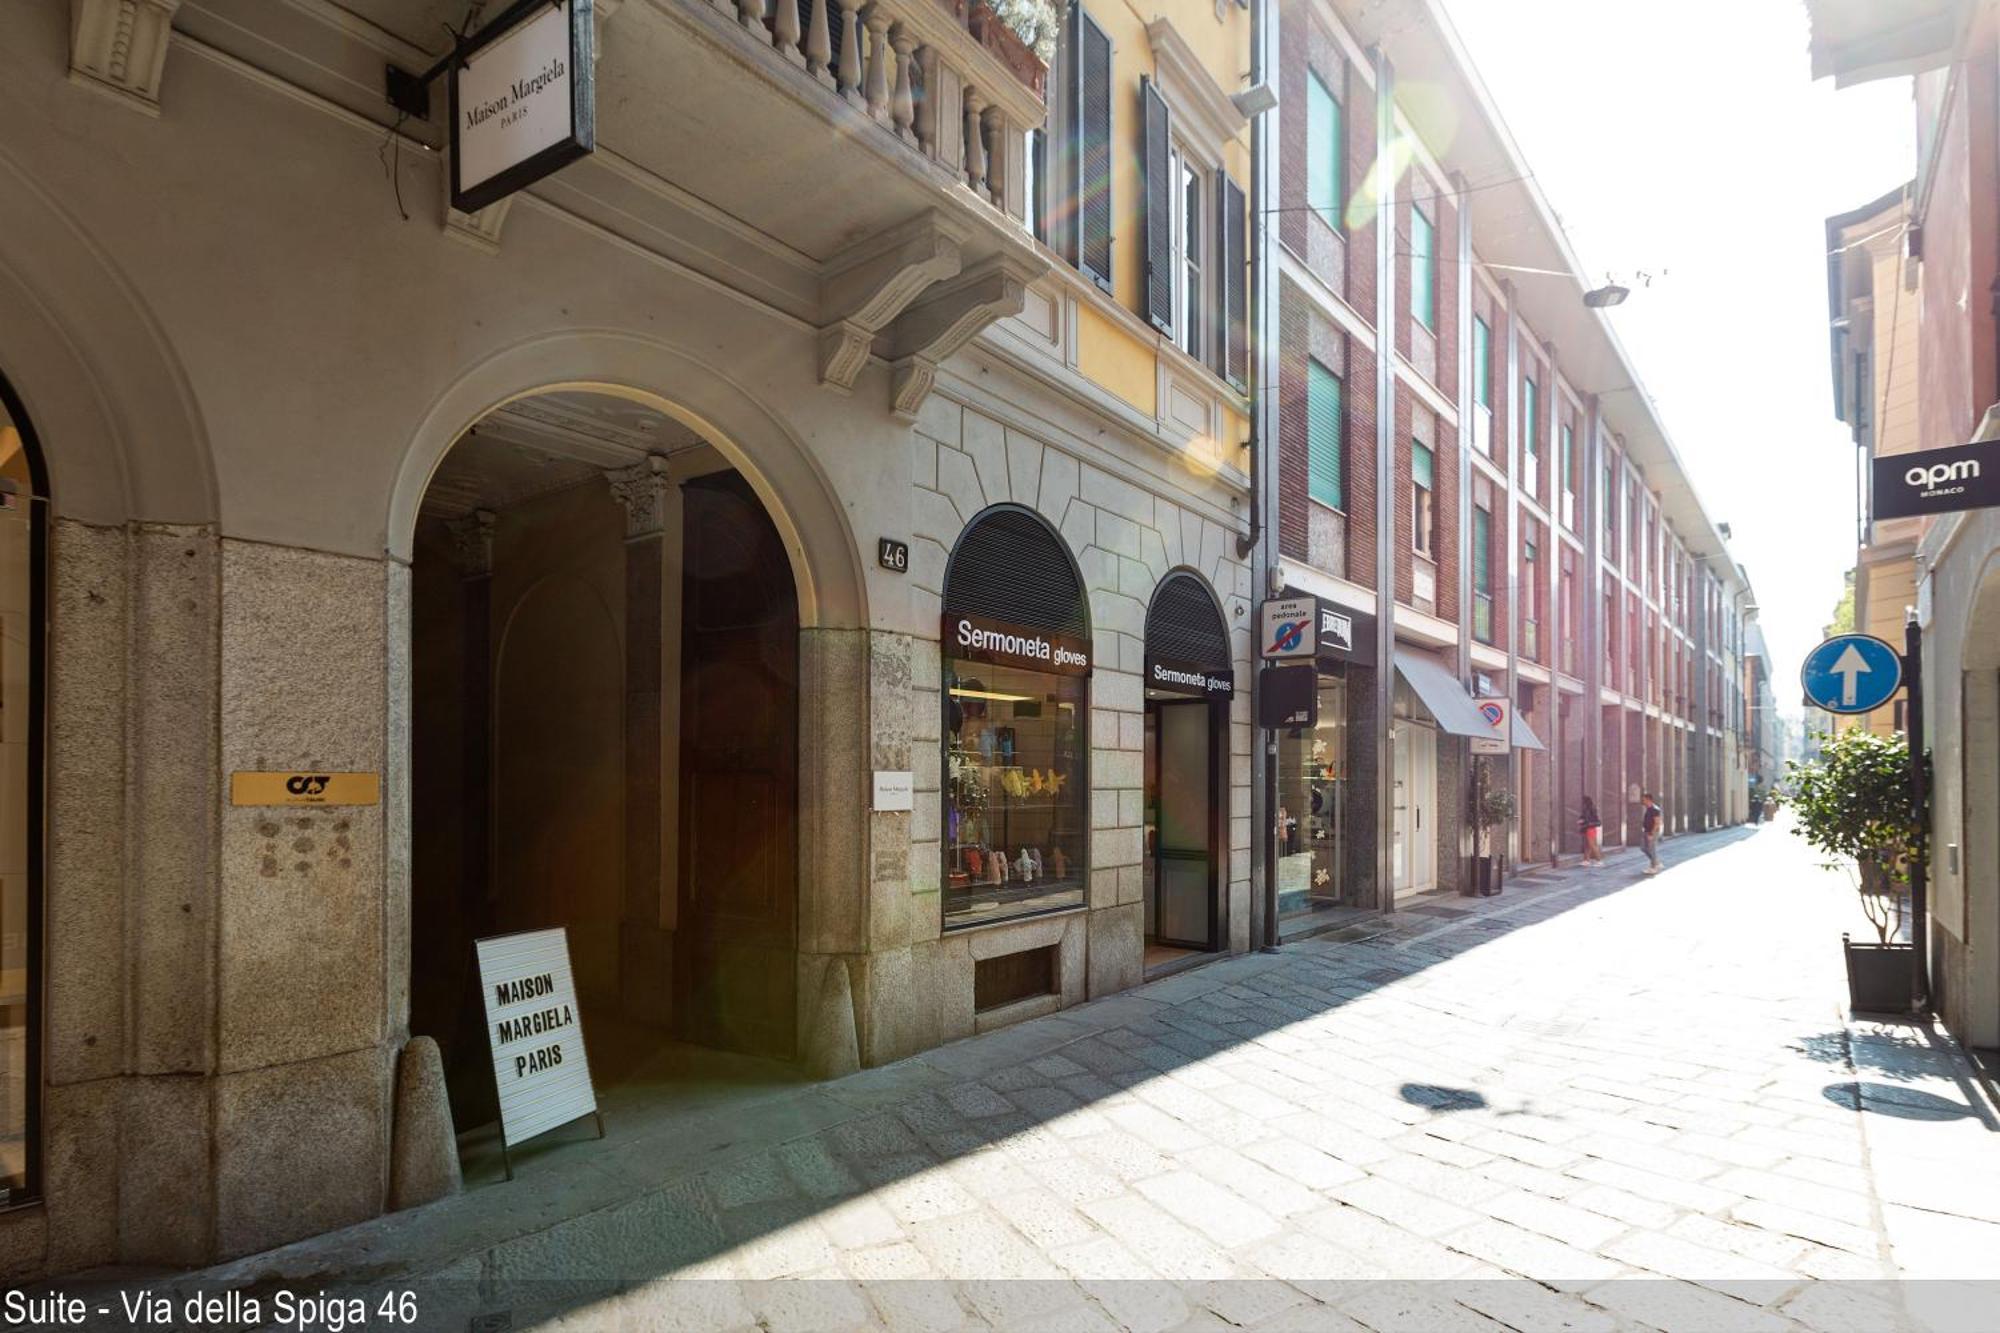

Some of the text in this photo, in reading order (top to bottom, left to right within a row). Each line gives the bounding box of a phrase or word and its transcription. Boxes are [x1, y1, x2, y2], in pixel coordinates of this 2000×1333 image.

[466, 58, 565, 130] Maison Margiela
[500, 105, 528, 129] PARIS
[1905, 460, 1980, 490] apm
[1920, 486, 1965, 498] MONACO
[884, 543, 905, 568] 46
[1272, 611, 1307, 624] pedonale
[957, 620, 1087, 666] Sermoneta gloves
[1154, 664, 1232, 692] Sermoneta gloves
[496, 973, 554, 1006] MAISON
[498, 1004, 573, 1044] MARGIELA
[515, 1044, 562, 1078] PARIS
